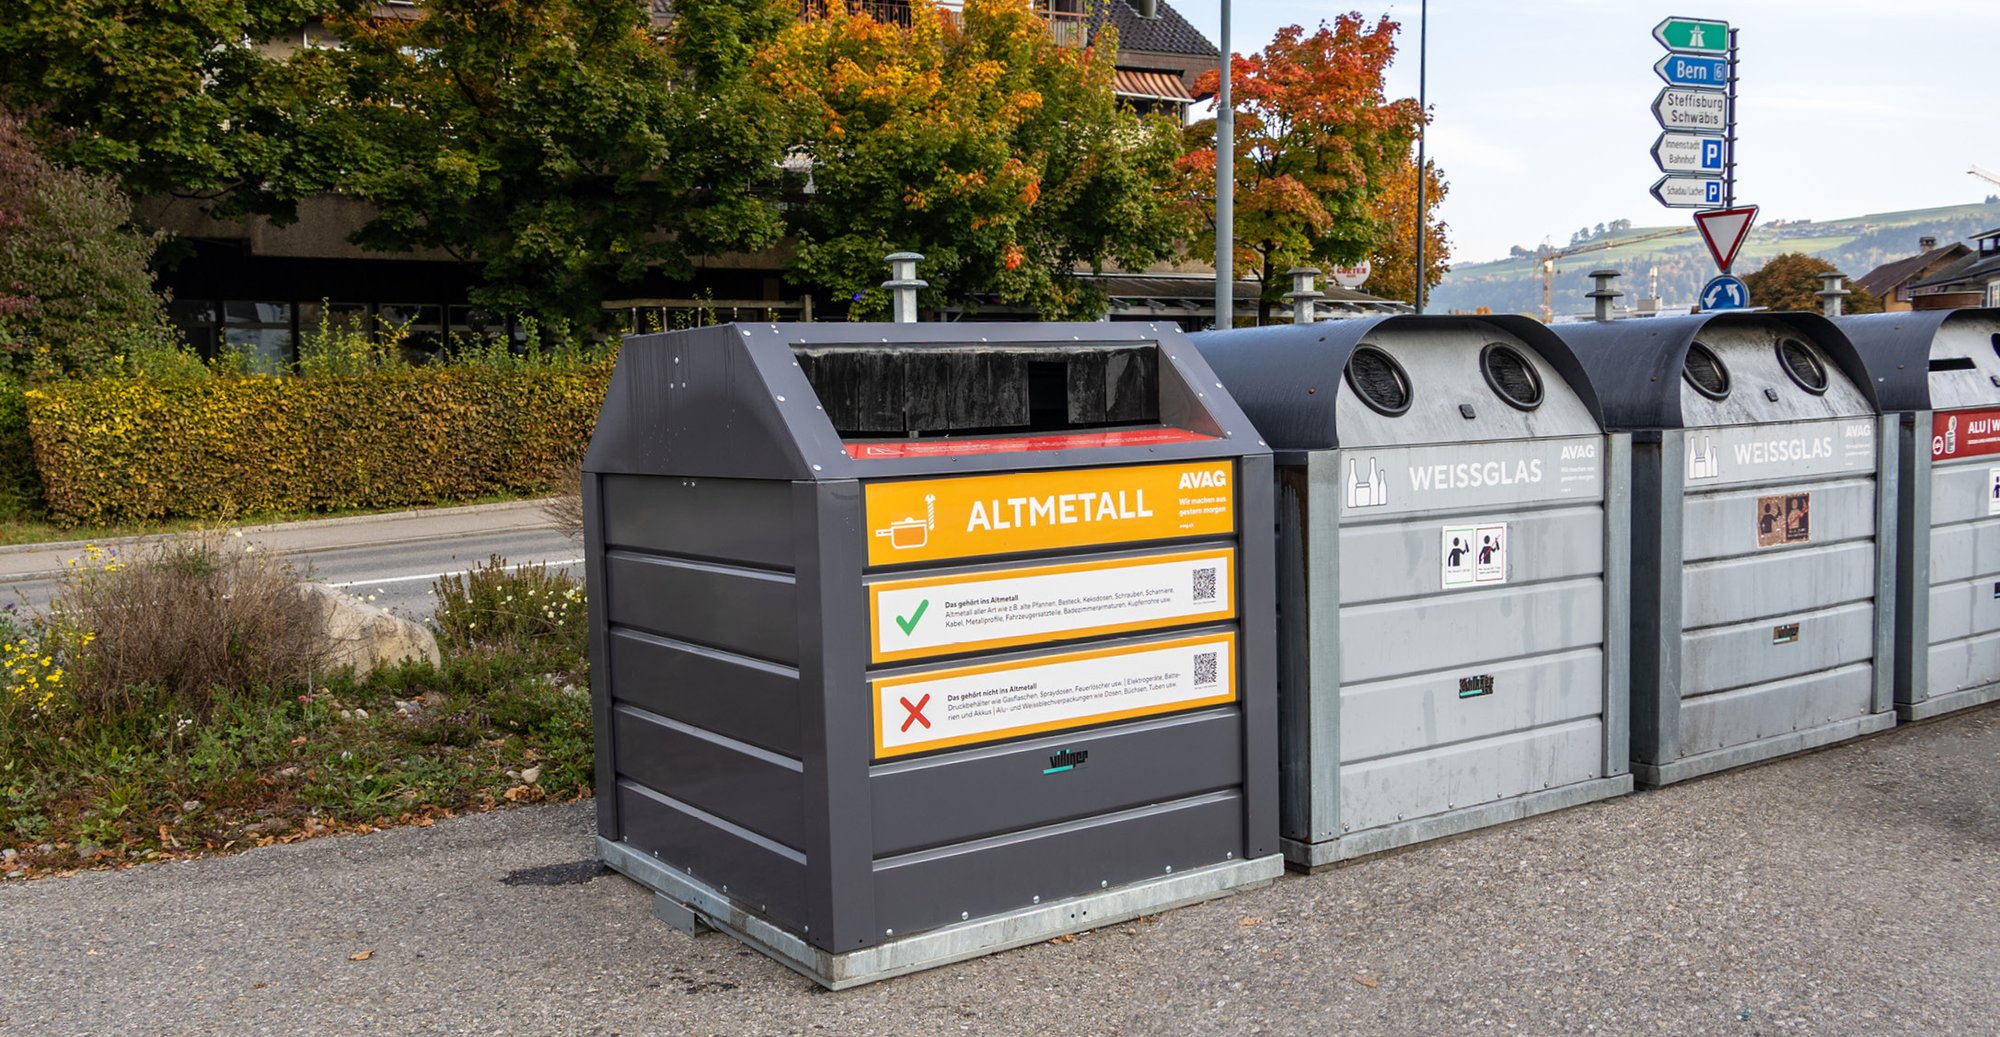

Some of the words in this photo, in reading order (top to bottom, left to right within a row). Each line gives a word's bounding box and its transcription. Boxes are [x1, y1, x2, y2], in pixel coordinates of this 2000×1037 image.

[1677, 60, 1707, 80] Bern
[1668, 93, 1723, 112] Steffisburg
[1671, 110, 1719, 124] Schwäbis
[1665, 140, 1700, 150] Innenstadt
[1706, 144, 1718, 166] P
[1669, 154, 1696, 164] Bahnhof
[1709, 184, 1718, 200] P
[1844, 424, 1871, 438] AVAG
[1560, 444, 1595, 460] AVAG
[1734, 437, 1832, 464] WEISSGLAS
[1178, 470, 1226, 490] AVAG
[1408, 458, 1542, 492] WEISSGLAS
[1191, 496, 1215, 504] machen
[966, 488, 1154, 532] ALTMETALL
[1179, 508, 1202, 517] gestern
[1203, 506, 1226, 514] morgen
[957, 599, 979, 608] gehört
[990, 595, 1018, 603] Altmetall
[1127, 598, 1159, 607] Kupferrohre
[945, 610, 972, 618] Altmetall
[947, 700, 990, 711] Druckbehälter
[1074, 682, 1110, 692] Feuerlöscher
[960, 691, 981, 701] gehört
[1009, 683, 1037, 692] Altmetall
